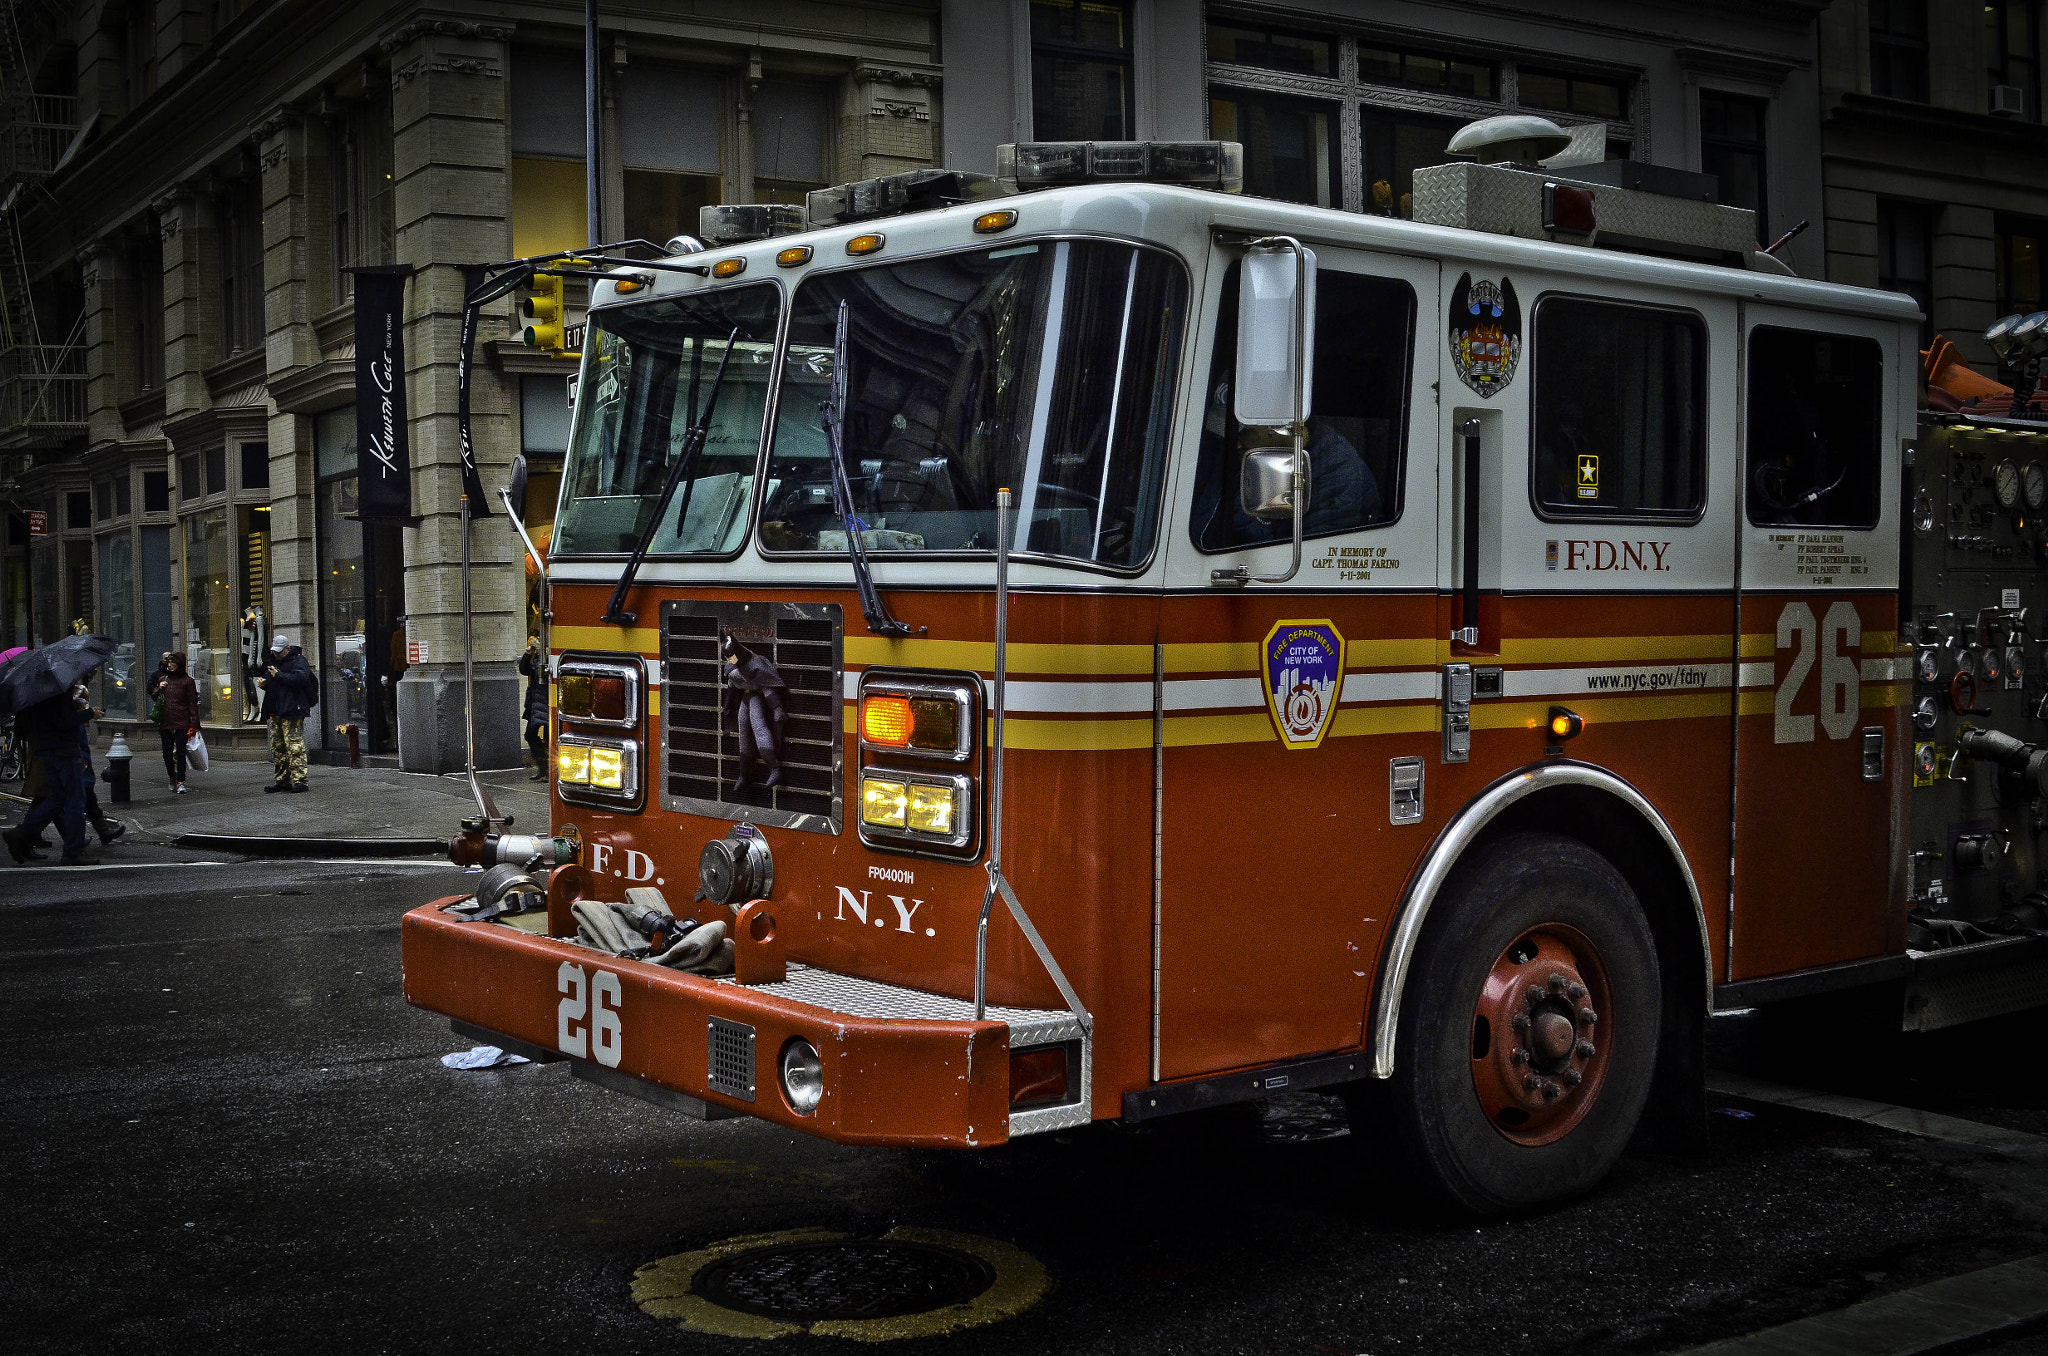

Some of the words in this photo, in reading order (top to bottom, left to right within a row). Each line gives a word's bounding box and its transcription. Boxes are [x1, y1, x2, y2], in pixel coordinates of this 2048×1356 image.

[1471, 285, 1501, 302] BATCAVE
[567, 330, 572, 349] E
[573, 328, 580, 346] 17
[1328, 547, 1338, 556] IN
[1340, 547, 1375, 557] MEMORY
[1376, 548, 1387, 557] OF
[1564, 540, 1671, 571] F.D.N.Y.
[1312, 559, 1335, 569] CAPT.
[1337, 559, 1368, 569] THOMAS
[1370, 560, 1400, 569] FARINO
[1340, 571, 1371, 580] 9-11-2001
[1273, 638, 1289, 660] FIRE
[1288, 629, 1335, 657] DEPARTMENT
[1289, 647, 1307, 656] CITY
[1308, 647, 1319, 656] OF
[1285, 656, 1301, 665] NEW
[1302, 655, 1323, 664] YORK
[1587, 667, 1708, 691] www.nyc.gov/fdny
[1774, 601, 1862, 745] 26
[590, 842, 665, 886] F.D.
[868, 865, 914, 885] FP04001H
[834, 885, 936, 937] N.Y.
[557, 960, 622, 1069] 26
